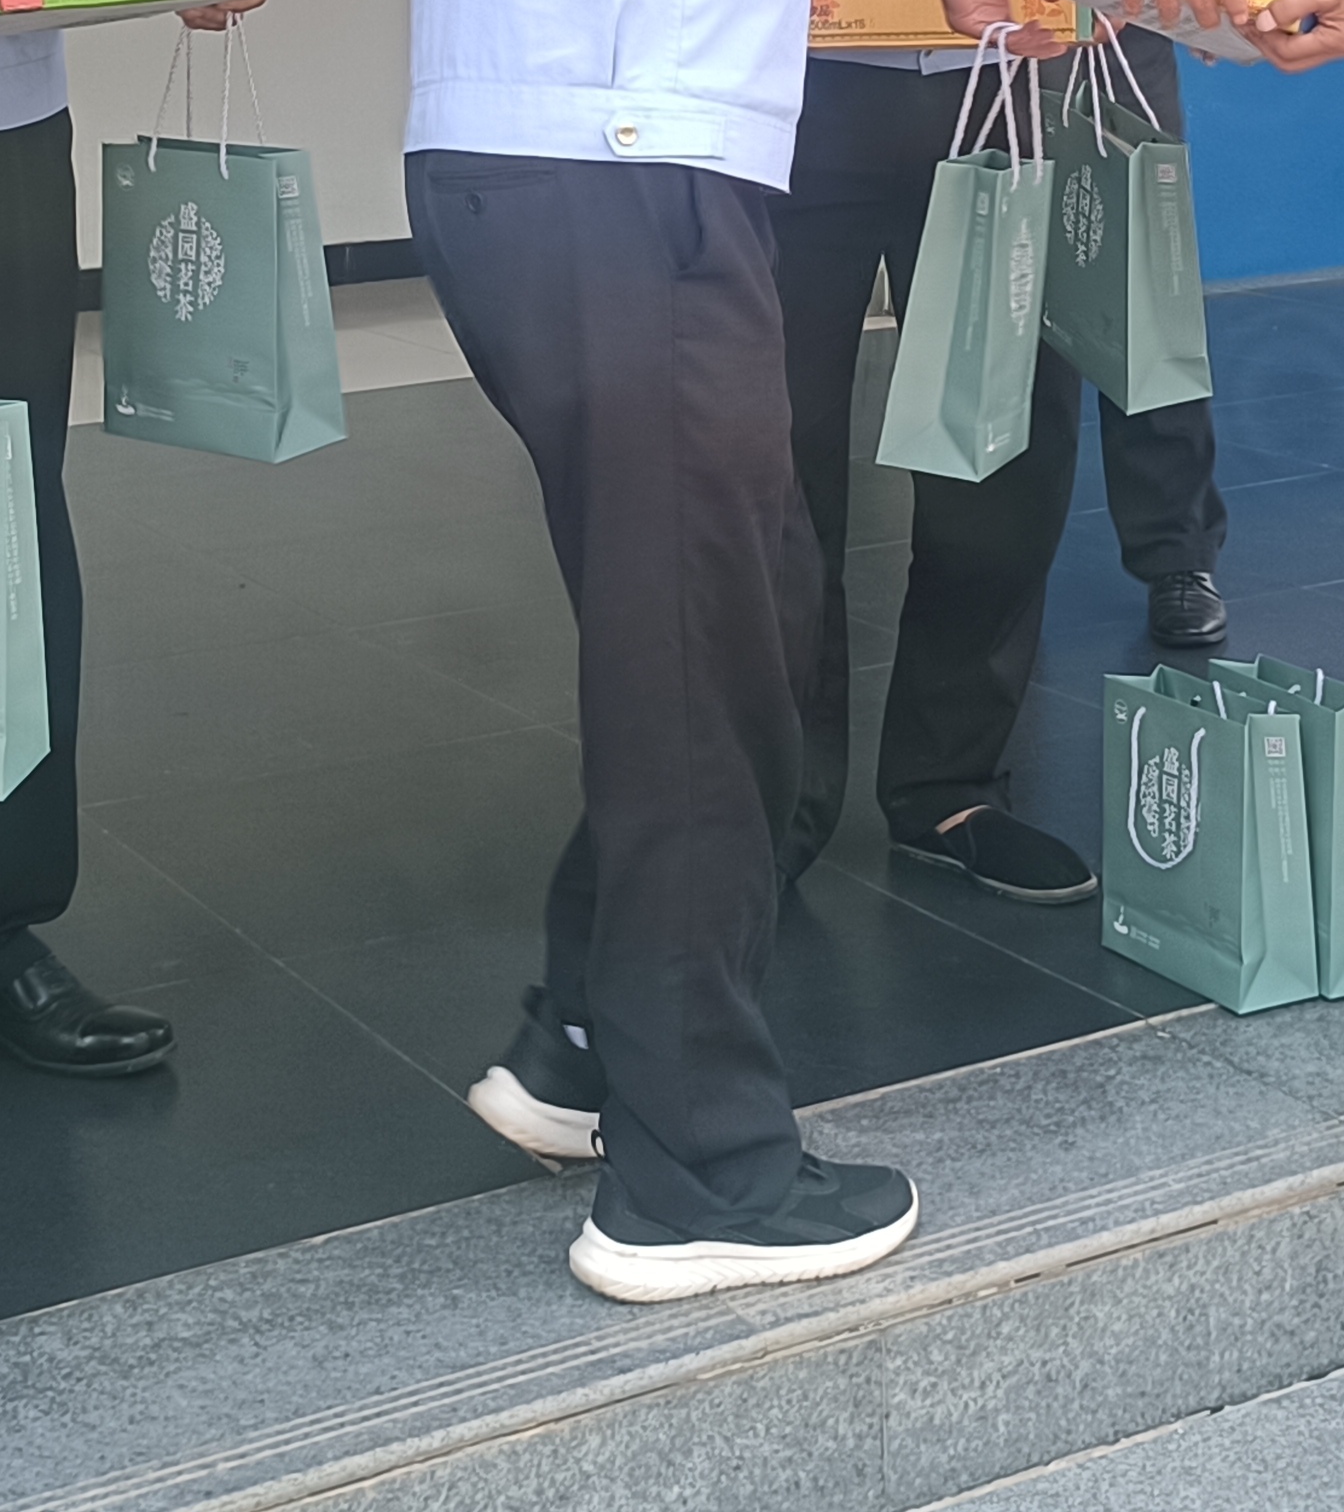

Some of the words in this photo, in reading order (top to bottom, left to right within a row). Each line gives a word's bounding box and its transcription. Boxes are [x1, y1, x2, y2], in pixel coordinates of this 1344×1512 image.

[175, 201, 199, 322] 盛园茗茶
[1161, 747, 1181, 860] 盛园茗茶
